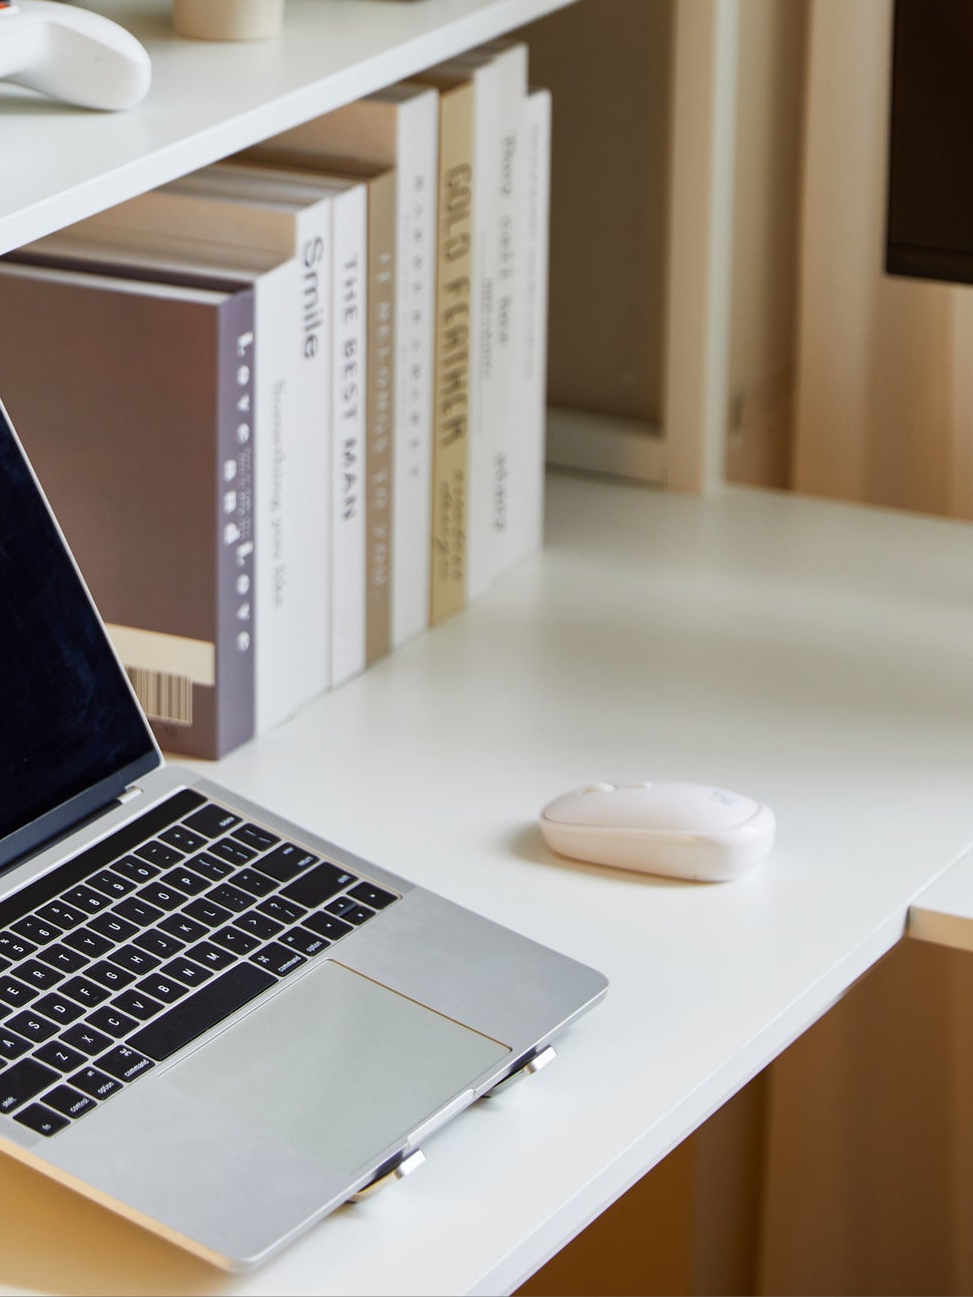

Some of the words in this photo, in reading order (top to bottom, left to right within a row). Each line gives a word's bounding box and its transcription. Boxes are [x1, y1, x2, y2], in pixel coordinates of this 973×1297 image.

[443, 162, 472, 264] GOLD
[341, 251, 359, 324] THE
[302, 234, 326, 360] Smile
[341, 337, 359, 422] BEST
[340, 436, 358, 522] MAN
[181, 877, 191, 885] P
[112, 883, 125, 891] 9
[157, 892, 170, 900] O
[88, 898, 101, 906] 8
[63, 913, 74, 921] 7
[108, 922, 121, 931] U
[179, 924, 192, 932] K
[38, 929, 50, 937] 6
[83, 938, 95, 946] Y
[157, 940, 167, 948] J
[305, 940, 323, 953] option
[12, 944, 25, 953] 5
[58, 953, 70, 962] T
[130, 955, 144, 964] H
[206, 952, 220, 961] M
[277, 954, 302, 972] command
[32, 970, 46, 979] R
[106, 971, 118, 980] G
[182, 968, 196, 977] N
[6, 986, 20, 995] E
[79, 987, 91, 996] F
[157, 985, 170, 993] B
[53, 1004, 66, 1014] D
[132, 1000, 144, 1009] V
[28, 1021, 40, 1030] S
[107, 1018, 120, 1026] C
[81, 1034, 94, 1043] X
[2, 1039, 15, 1048] A
[55, 1051, 69, 1061] Z
[124, 1058, 150, 1077] command
[97, 1081, 115, 1094] option
[69, 1097, 90, 1113] control
